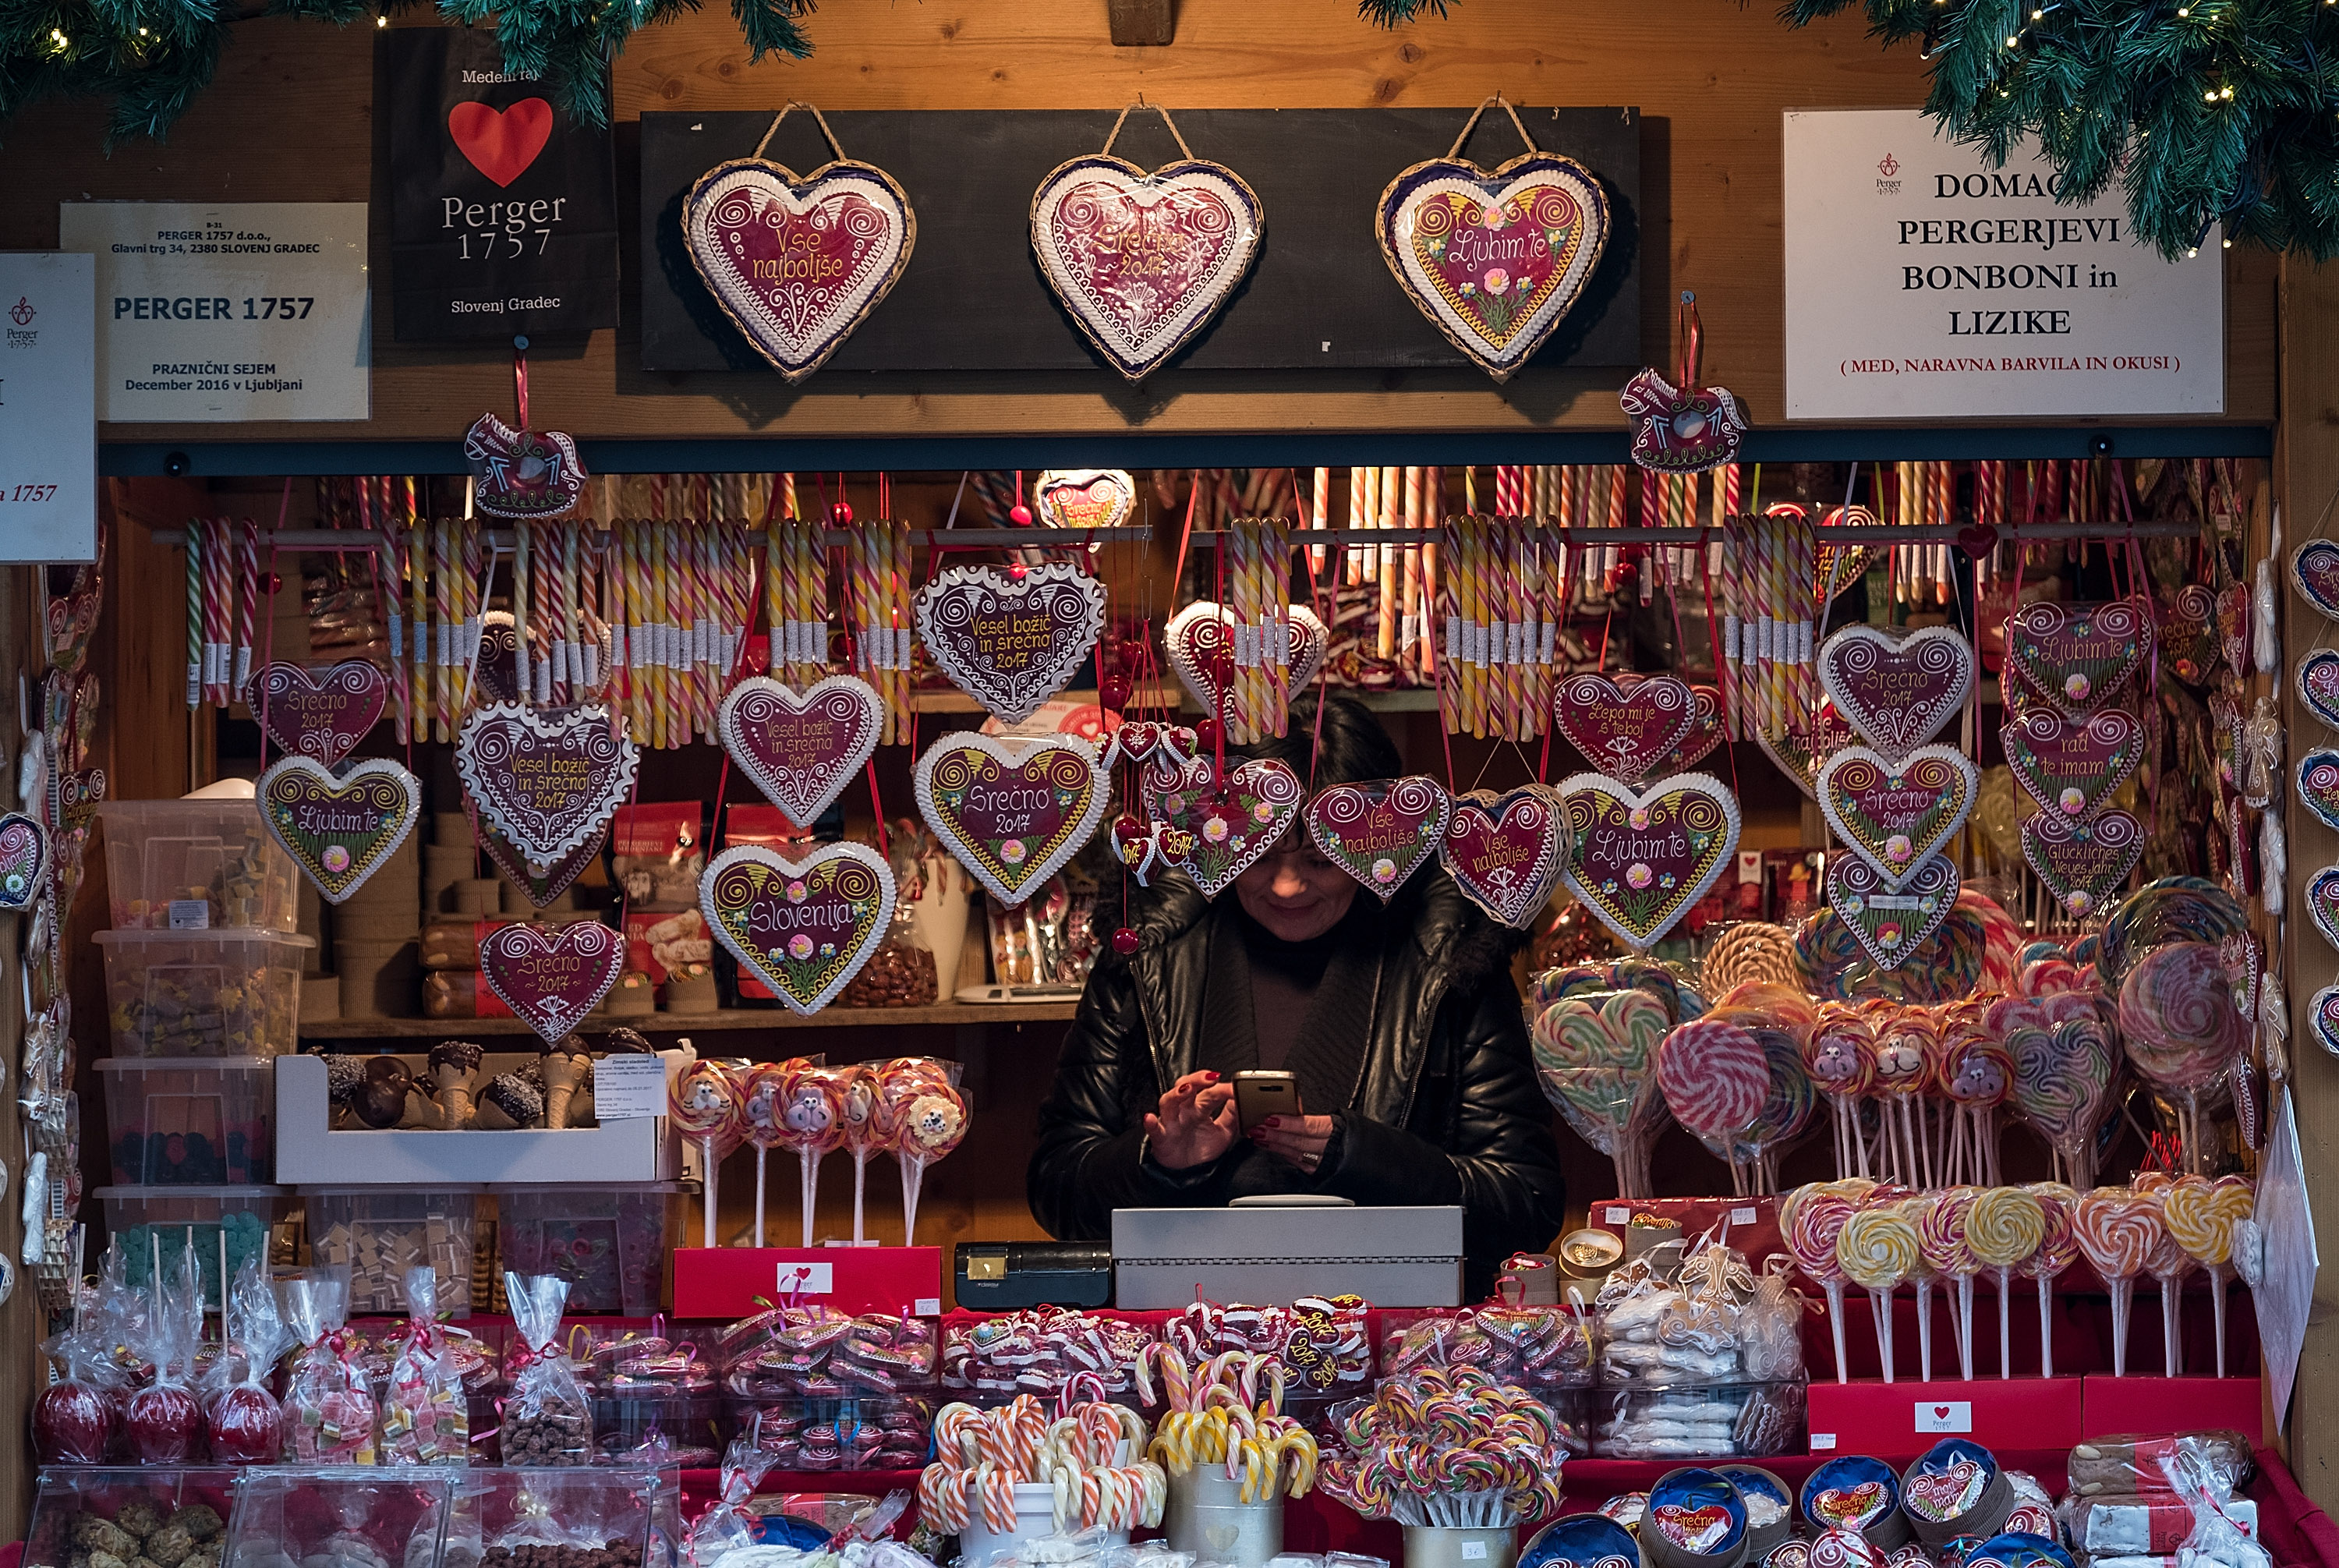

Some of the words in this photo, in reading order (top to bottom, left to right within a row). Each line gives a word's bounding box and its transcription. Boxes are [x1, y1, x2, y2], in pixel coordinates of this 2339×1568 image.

[1876, 179, 1902, 189] Perger
[441, 196, 565, 234] Perger
[157, 231, 203, 240] PERGER
[206, 231, 233, 240] 1757
[458, 228, 550, 260] 1757
[776, 225, 821, 253] Vse
[1898, 218, 2121, 251] PERGERJEVI
[111, 244, 147, 253] Glavni
[150, 245, 166, 256] trg
[169, 245, 187, 255] 34,
[190, 244, 218, 253] 2380
[221, 244, 271, 253] SLOVENJ
[274, 244, 320, 253] GRADEC
[1449, 228, 1525, 271] Ljubim
[1528, 228, 1548, 259] te
[752, 253, 843, 286] najboljše
[1120, 256, 1165, 277] 2017
[1902, 264, 2077, 291] BONBONI
[2088, 264, 2118, 288] in
[113, 297, 233, 320] PERGER
[242, 297, 314, 320] 1757
[451, 299, 504, 313] Slovenj
[508, 296, 561, 311] Gradec
[1948, 310, 2071, 335] LIZIKE
[7, 328, 38, 341] Perger
[152, 360, 229, 374] PRAZNIČNI
[233, 363, 276, 375] SEJEM
[1851, 359, 1900, 375] MED,
[1904, 358, 1996, 373] NARAVNA
[2001, 356, 2081, 372] BARVILA
[2086, 356, 2107, 370] IN
[2112, 356, 2170, 370] OKUSI
[126, 380, 193, 391] December
[196, 380, 229, 390] 2016
[245, 379, 303, 392] Ljubljani
[12, 484, 58, 502] 1757
[970, 614, 1009, 635] Vesel
[1014, 614, 1051, 633] božič
[979, 636, 993, 653] in
[996, 632, 1051, 651] srečno
[2040, 636, 2106, 667] Ljubim
[2108, 636, 2122, 657] te
[996, 652, 1028, 668] 2017
[1861, 668, 1929, 690] Srečno
[284, 690, 347, 711] Srečno
[1881, 689, 1914, 707] 2017
[301, 713, 334, 728] 2017
[1588, 702, 1626, 724] Lepo
[1628, 705, 1643, 720] mi
[1645, 704, 1656, 722] je
[765, 719, 799, 738] Vesel
[802, 719, 833, 736] božič
[1611, 720, 1644, 738] teboj
[771, 740, 784, 754] in
[784, 737, 833, 753] srečno
[2061, 733, 2090, 753] rad
[509, 752, 547, 773] Vesel
[551, 754, 590, 773] božič
[787, 753, 817, 769] 2017
[2040, 756, 2056, 776] te
[2060, 758, 2105, 775] imam
[518, 774, 533, 791] in
[534, 774, 587, 791] srečno
[535, 791, 568, 809] 2017
[964, 784, 1049, 814] Srečno
[1862, 788, 1930, 812] Srečno
[298, 805, 363, 835] Ljubim
[363, 807, 379, 831] te
[995, 813, 1031, 834] 2017
[1364, 809, 1395, 830] Vse
[1882, 811, 1918, 829] 2017
[1166, 831, 1193, 855] 2017
[1345, 829, 1417, 856] najboljše
[1481, 833, 1510, 853] Vse
[1593, 830, 1665, 870] Ljubim
[1668, 830, 1686, 858] te
[1473, 844, 1530, 873] najboljše
[2051, 859, 2086, 875] Neues
[2088, 859, 2114, 875] Jahr
[2069, 874, 2093, 889] 2017
[747, 899, 855, 935] Slovenija
[517, 954, 581, 975] Srečno
[537, 975, 570, 993] 2017
[1304, 1311, 1336, 1338] 2017
[1290, 1337, 1318, 1365] 2017
[1313, 1356, 1339, 1388] 2017
